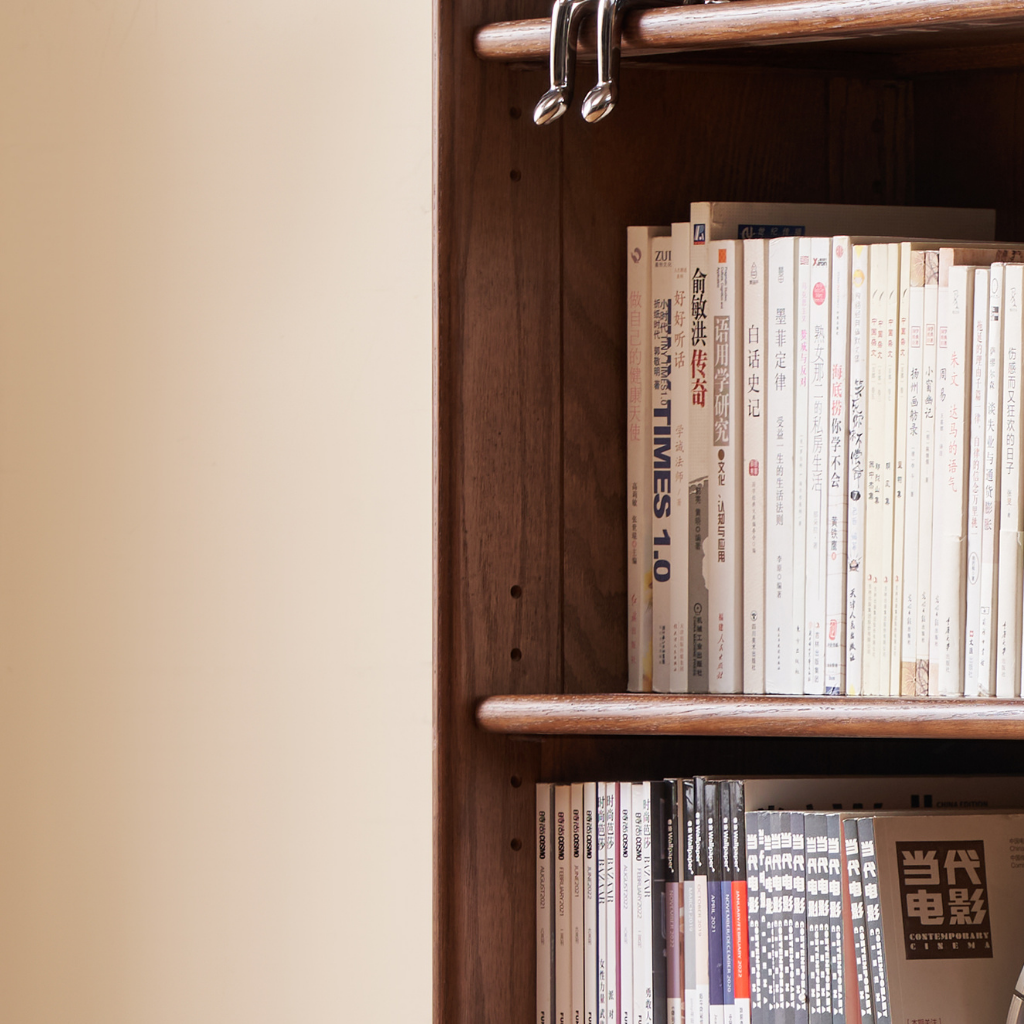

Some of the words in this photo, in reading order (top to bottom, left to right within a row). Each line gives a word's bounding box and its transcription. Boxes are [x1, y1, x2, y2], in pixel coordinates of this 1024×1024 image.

[655, 251, 671, 261] ZUI
[660, 299, 668, 334] 小时代
[674, 290, 686, 368] 好好听话
[691, 267, 708, 408] 俞敏洪传奇
[775, 308, 786, 391] 墨菲定律
[629, 291, 642, 442] 做自己的健康天使
[714, 317, 729, 444] 语用学研究
[747, 324, 760, 418] 白话史记
[910, 368, 919, 436] 扬州画舫录
[924, 366, 933, 419] 小窗幽记
[940, 368, 947, 402] 周易
[950, 351, 959, 387] 朱文
[831, 364, 843, 488] 海底捞你学不会
[948, 404, 958, 493] 达马的语气
[1006, 348, 1017, 475] 伤感而又狂欢的日子
[653, 400, 671, 518] TIMES
[775, 416, 785, 526] 受益一生的生活法则
[984, 402, 996, 531] 谈失业与通货膨胀
[653, 529, 671, 582] 1.0
[747, 834, 759, 913] 当代电影
[771, 834, 783, 913] 当代电影
[781, 832, 793, 912] 当代电影
[792, 834, 805, 914] 当代电影
[806, 837, 818, 917] 当代电影
[816, 836, 829, 916] 当代电影
[828, 837, 842, 918] 当代电影
[845, 838, 864, 920] 当代电影
[861, 840, 880, 921] 当代电影
[901, 849, 982, 886] 当代
[906, 888, 987, 925] 电影
[909, 932, 990, 941] CONTEMPORARY
[910, 942, 991, 950] CINEMA
